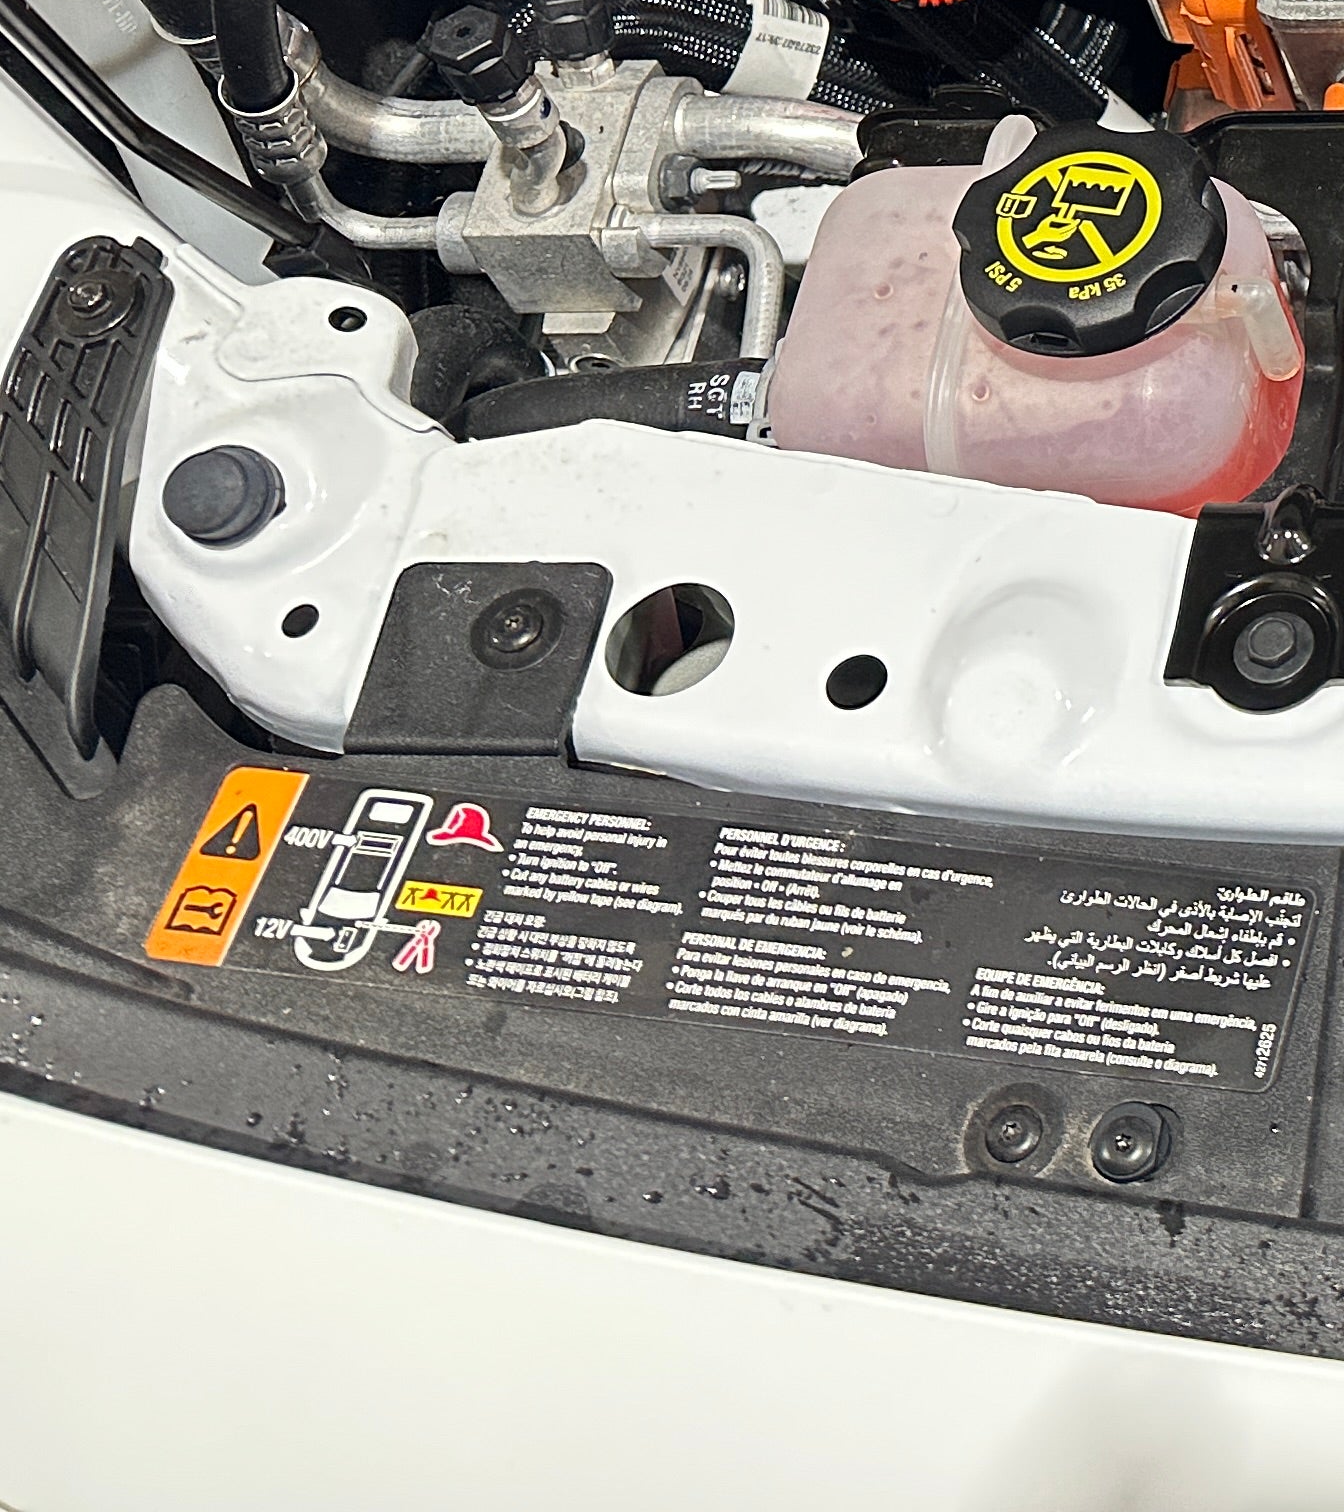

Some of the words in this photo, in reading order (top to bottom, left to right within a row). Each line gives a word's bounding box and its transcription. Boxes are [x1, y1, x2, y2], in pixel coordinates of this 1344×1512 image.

[984, 260, 1013, 286] PSI
[1004, 276, 1022, 292] 5
[1102, 272, 1126, 292] 35
[1068, 281, 1101, 300] kPa
[687, 381, 707, 408] RH
[706, 374, 730, 419] SGT
[525, 806, 589, 825] EMERGENCY
[588, 812, 652, 831] PERSONNEL:
[283, 826, 331, 852] 400V
[513, 838, 527, 851] an
[521, 822, 533, 836] To
[533, 823, 555, 838] help
[556, 825, 584, 841] avoid
[583, 828, 626, 845] personal
[627, 833, 655, 848] injury
[656, 835, 668, 849] in
[719, 825, 779, 846] PERSONNEL
[517, 853, 538, 867] Turn
[540, 855, 576, 871] ignition
[577, 859, 589, 872] to
[714, 841, 738, 856] Pour
[739, 845, 767, 860] éviter
[769, 848, 799, 864] toutes
[801, 852, 849, 870] blessures
[850, 858, 905, 877] corporelles
[906, 866, 920, 879] en
[921, 867, 940, 882] cas
[941, 870, 993, 888] d'urgence,
[718, 858, 751, 874] Mettez
[753, 863, 763, 875] le
[764, 864, 830, 884] commutateur
[831, 873, 887, 891] d'allumage
[888, 880, 902, 893] en
[510, 868, 528, 882] Cut
[528, 870, 547, 884] any
[548, 872, 583, 888] battery
[585, 876, 616, 891] cables
[618, 879, 630, 893] or
[631, 880, 659, 896] wires
[711, 873, 752, 891] position
[761, 880, 778, 894] Off
[503, 885, 541, 901] marked
[542, 888, 556, 903] by
[555, 890, 589, 906] yellow
[589, 893, 613, 908] tape
[614, 896, 635, 911] (see
[707, 888, 743, 906] Couper
[744, 893, 767, 909] tous
[769, 896, 783, 911] les
[819, 902, 832, 917] ou
[834, 904, 849, 919] fils
[851, 907, 865, 921] de
[866, 908, 906, 926] batterie
[253, 916, 292, 942] 12V
[682, 930, 738, 950] PERSONAL
[738, 937, 753, 952] DE
[754, 939, 826, 961] EMERGENCIA:
[676, 947, 700, 962] Para
[701, 950, 731, 966] evitar
[732, 954, 774, 971] lesiones
[774, 959, 831, 979] personales
[832, 967, 845, 980] en
[846, 968, 870, 983] caso
[872, 972, 886, 985] de
[975, 965, 1014, 984] EQUIPE
[1016, 970, 1032, 986] DE
